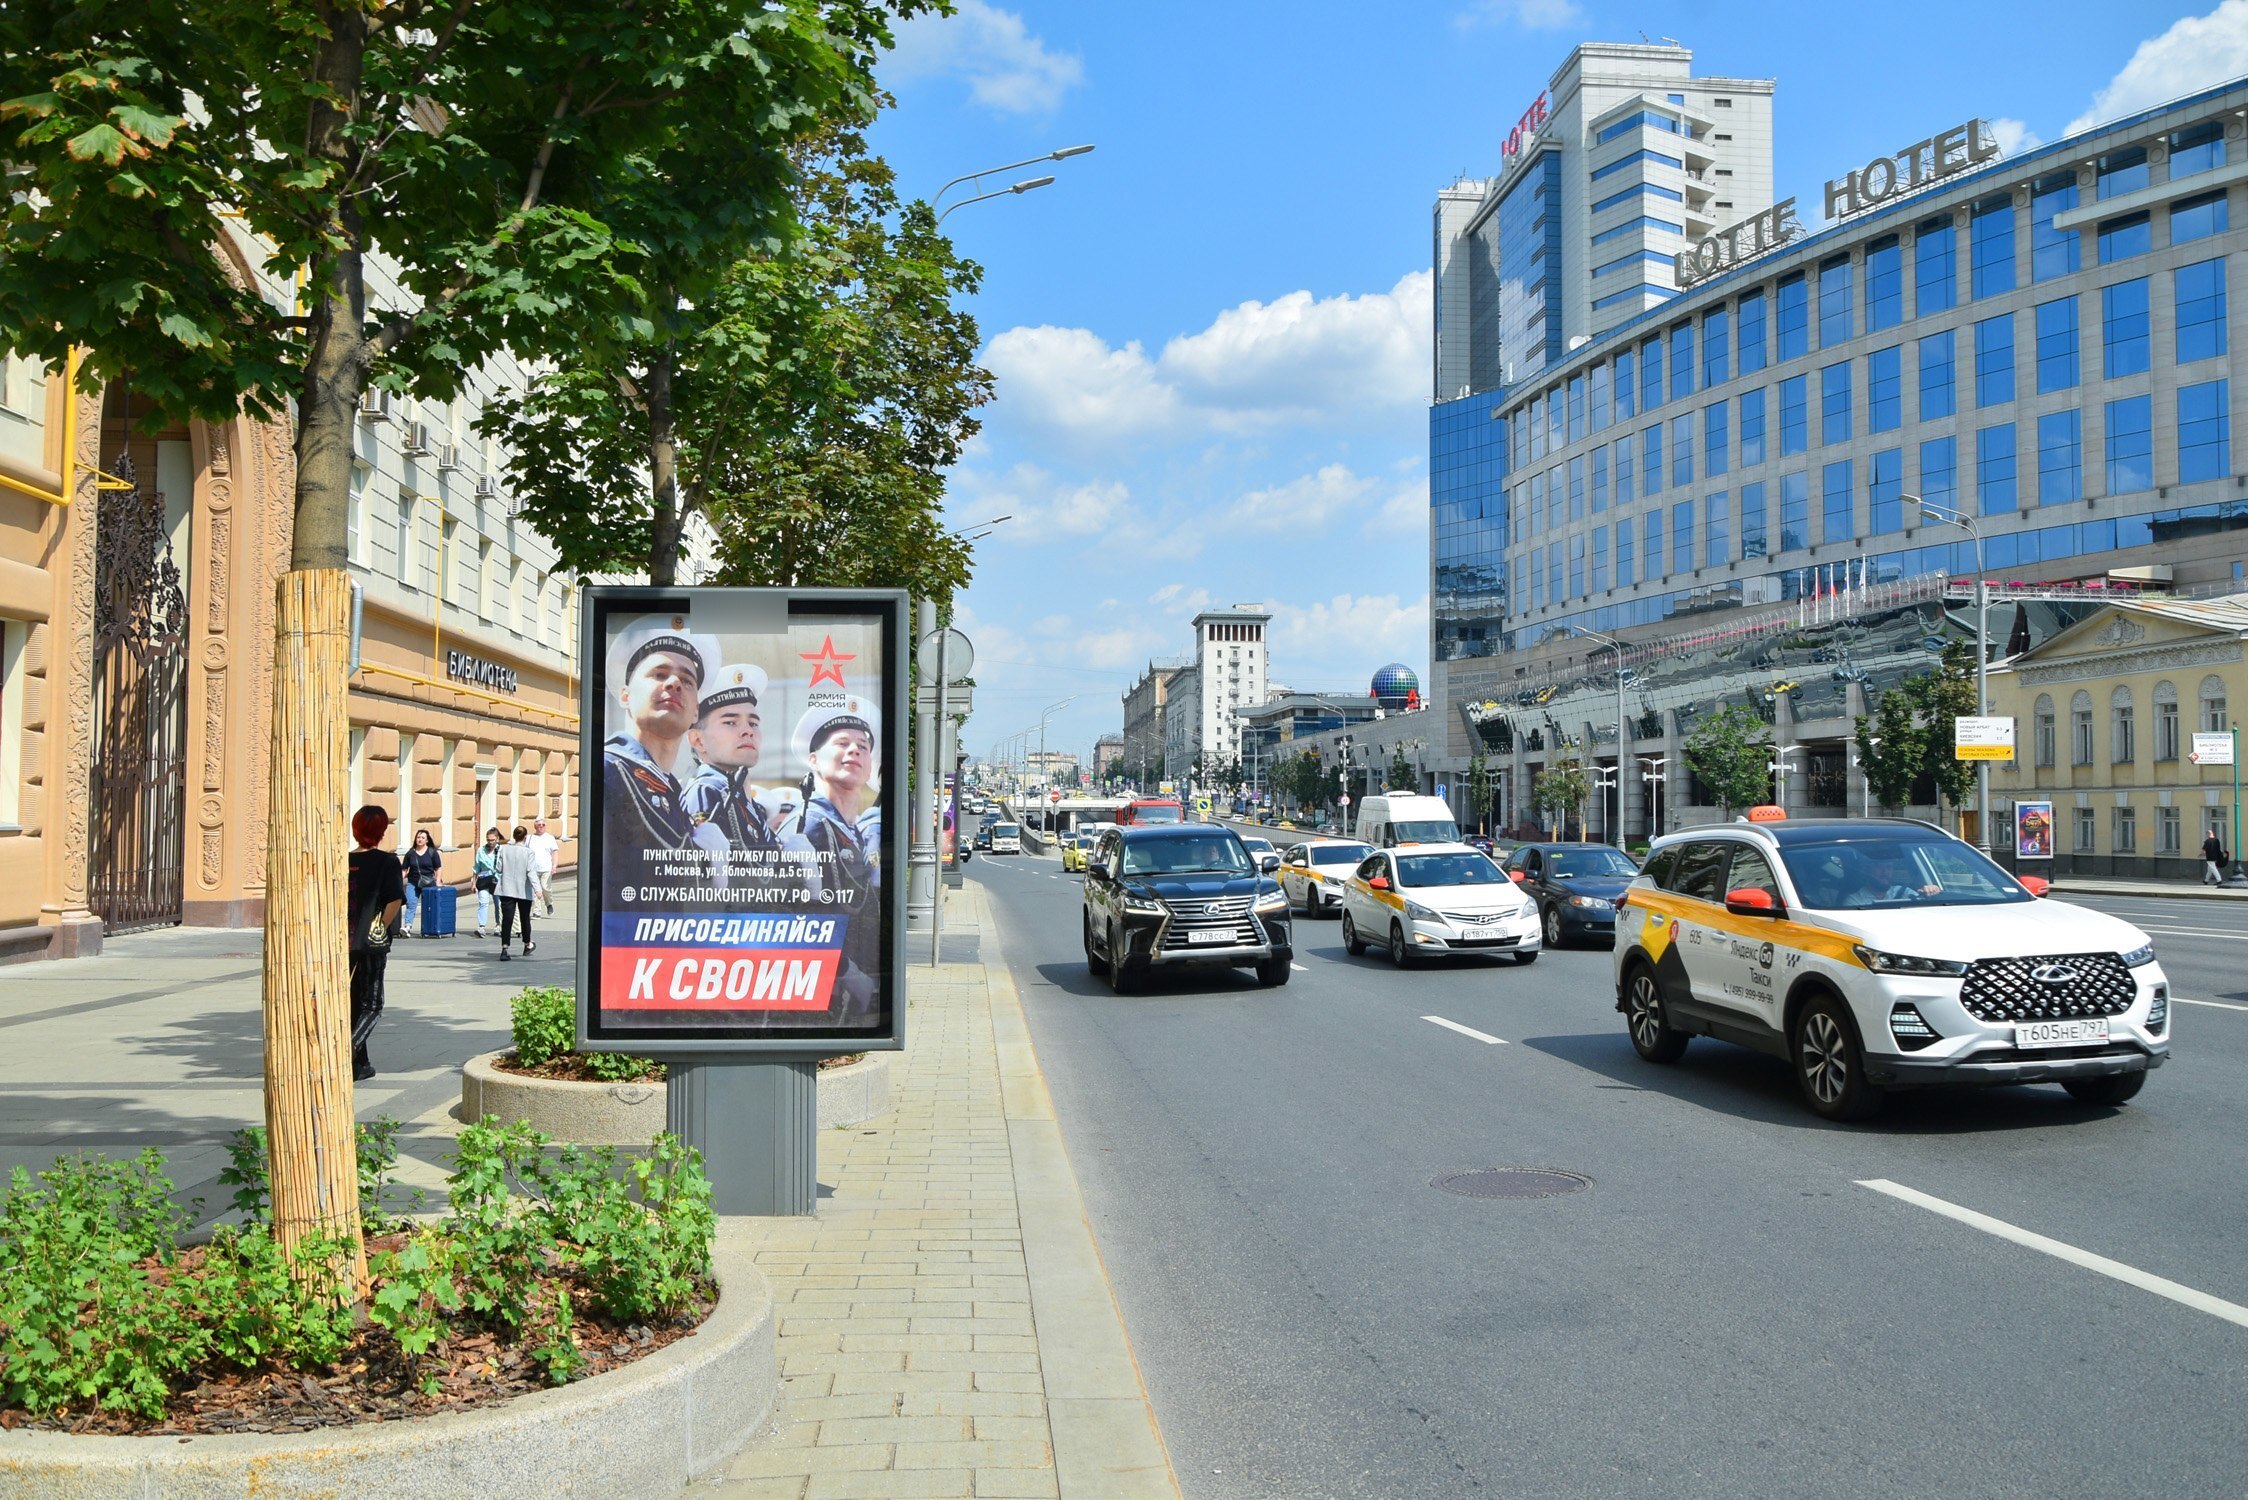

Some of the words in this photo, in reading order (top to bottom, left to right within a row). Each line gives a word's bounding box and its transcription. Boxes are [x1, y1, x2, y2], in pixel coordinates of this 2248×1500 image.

[1674, 196, 1796, 287] LOTTE
[1824, 118, 1998, 220] HOTEL
[449, 651, 517, 692] БИБЛИОТЕКА
[643, 849, 673, 861] ПУНКТ
[674, 849, 710, 862] ОТБОРА
[712, 850, 724, 862] НА
[726, 850, 764, 863] СЛУЖБУ
[766, 850, 779, 862] ПО
[780, 851, 837, 863] КОНТРАКТУ:
[655, 866, 662, 876] г.
[664, 865, 704, 878] Москва,
[706, 866, 720, 878] ул.
[722, 865, 778, 878] Яблочкова,
[779, 866, 794, 878] д.5
[796, 868, 816, 879] стр.
[818, 866, 824, 877] 1
[640, 887, 811, 903] СЛУЖБАПОКОНТРАКТУ.РФ
[836, 889, 854, 903] 117
[634, 915, 836, 944] ПРИСОЕДИНЯЙСЯ
[1690, 930, 1702, 944] 605
[1730, 940, 1758, 961] Яндекс
[1760, 946, 1772, 964] Go
[628, 958, 664, 1000] К
[669, 958, 822, 1001] СВОИМ
[1748, 967, 1772, 988] Такси
